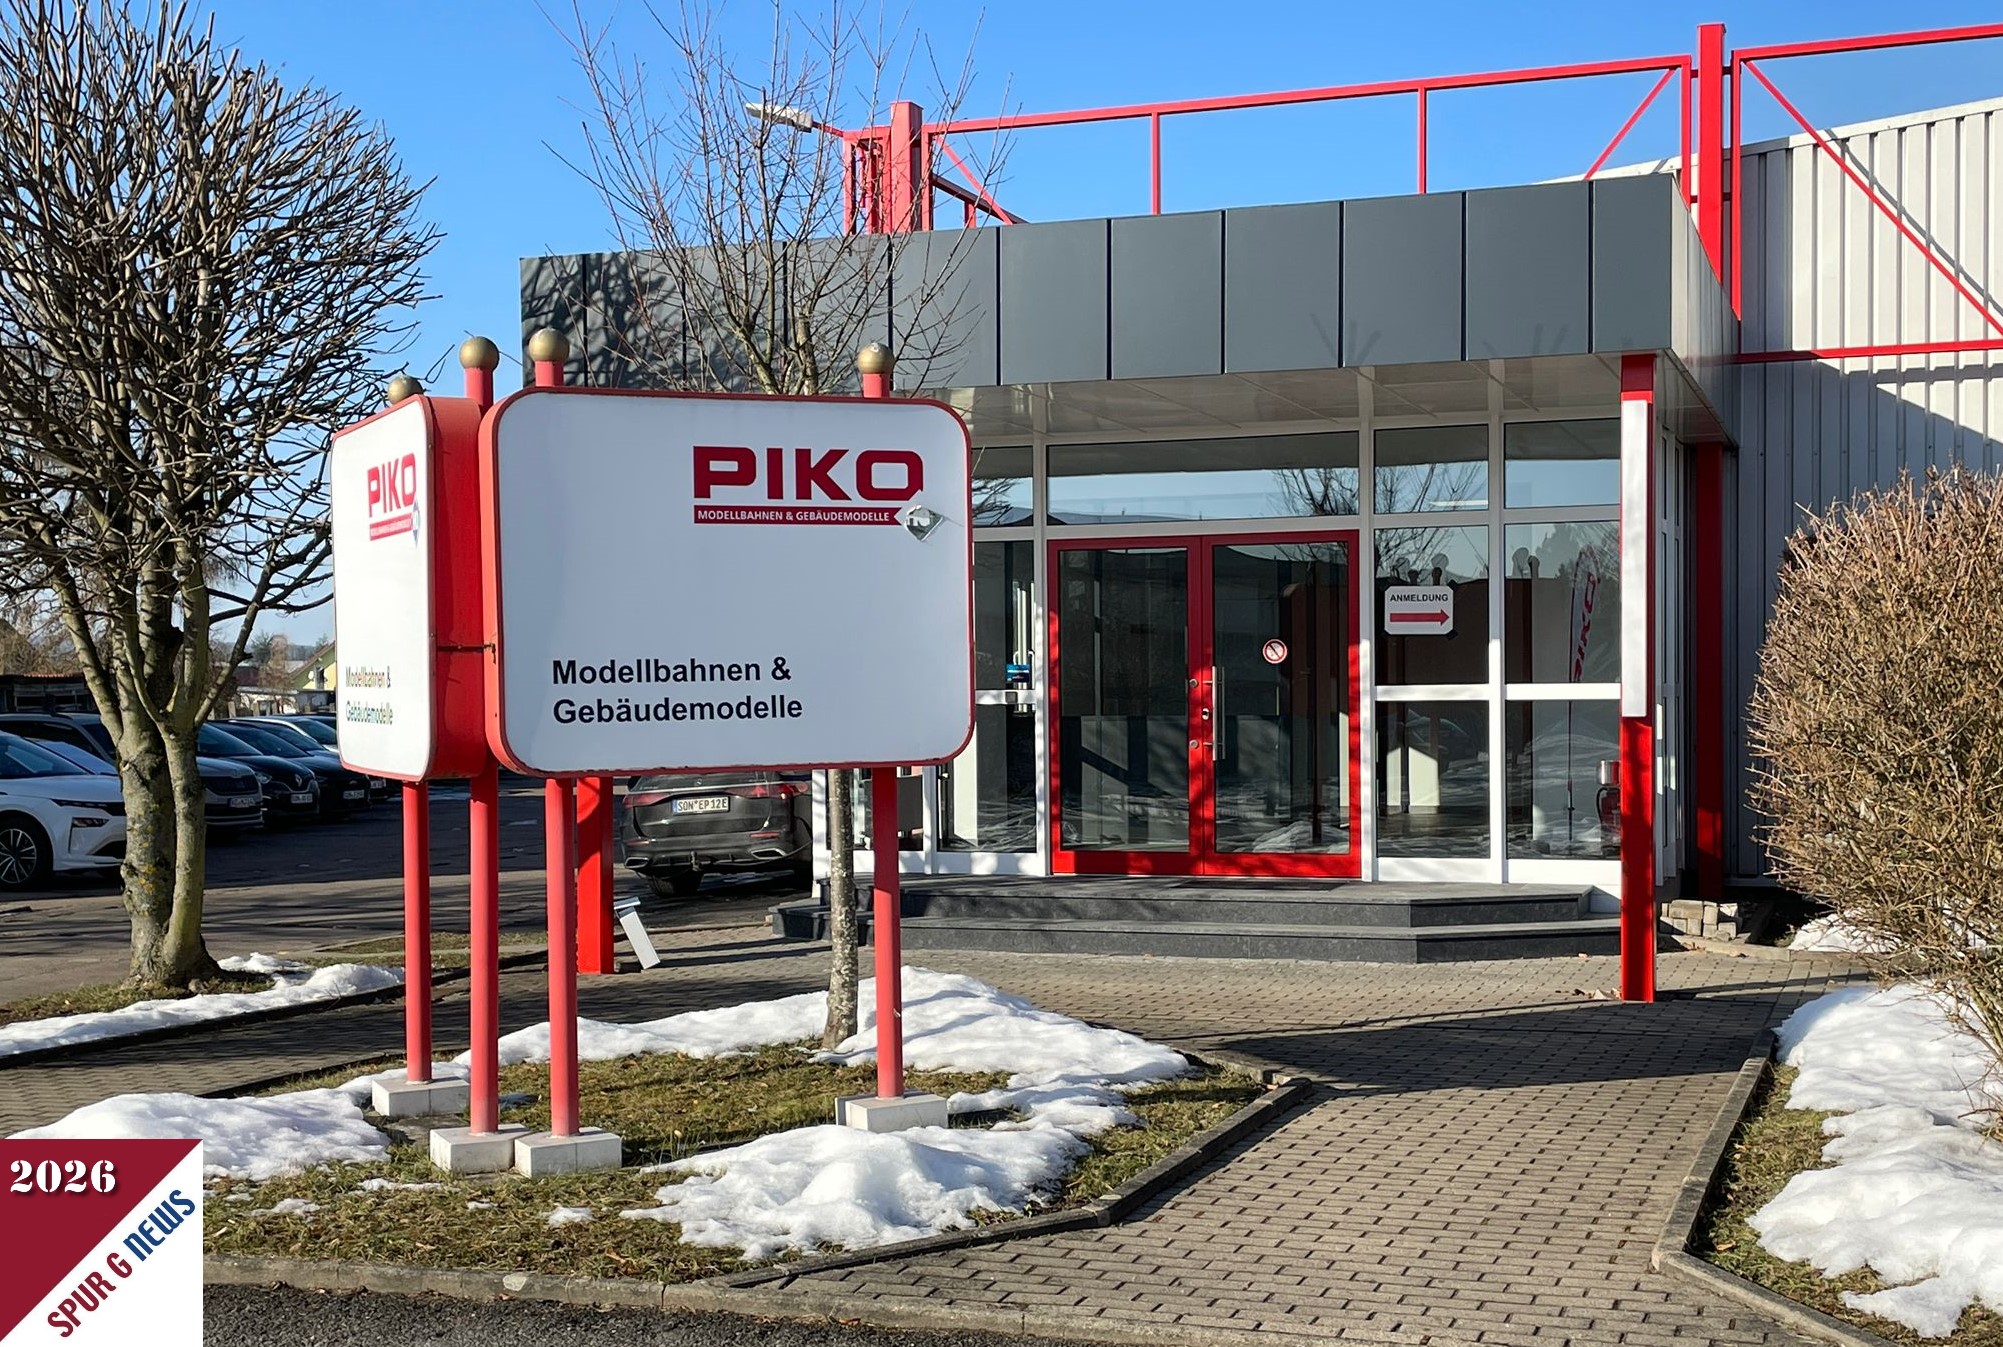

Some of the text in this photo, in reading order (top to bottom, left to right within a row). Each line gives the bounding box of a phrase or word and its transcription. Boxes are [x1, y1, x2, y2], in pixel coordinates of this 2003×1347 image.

[367, 453, 416, 518] PIKO
[693, 445, 923, 501] PIKO
[697, 509, 890, 522] MODELLBAHNEN & GEBÄUDEMODELLE
[1390, 593, 1449, 602] ANMELDUNG
[345, 665, 386, 688] Modellbahnen
[553, 656, 792, 685] Modellbahnen &
[553, 694, 803, 724] Gebäudemodelle
